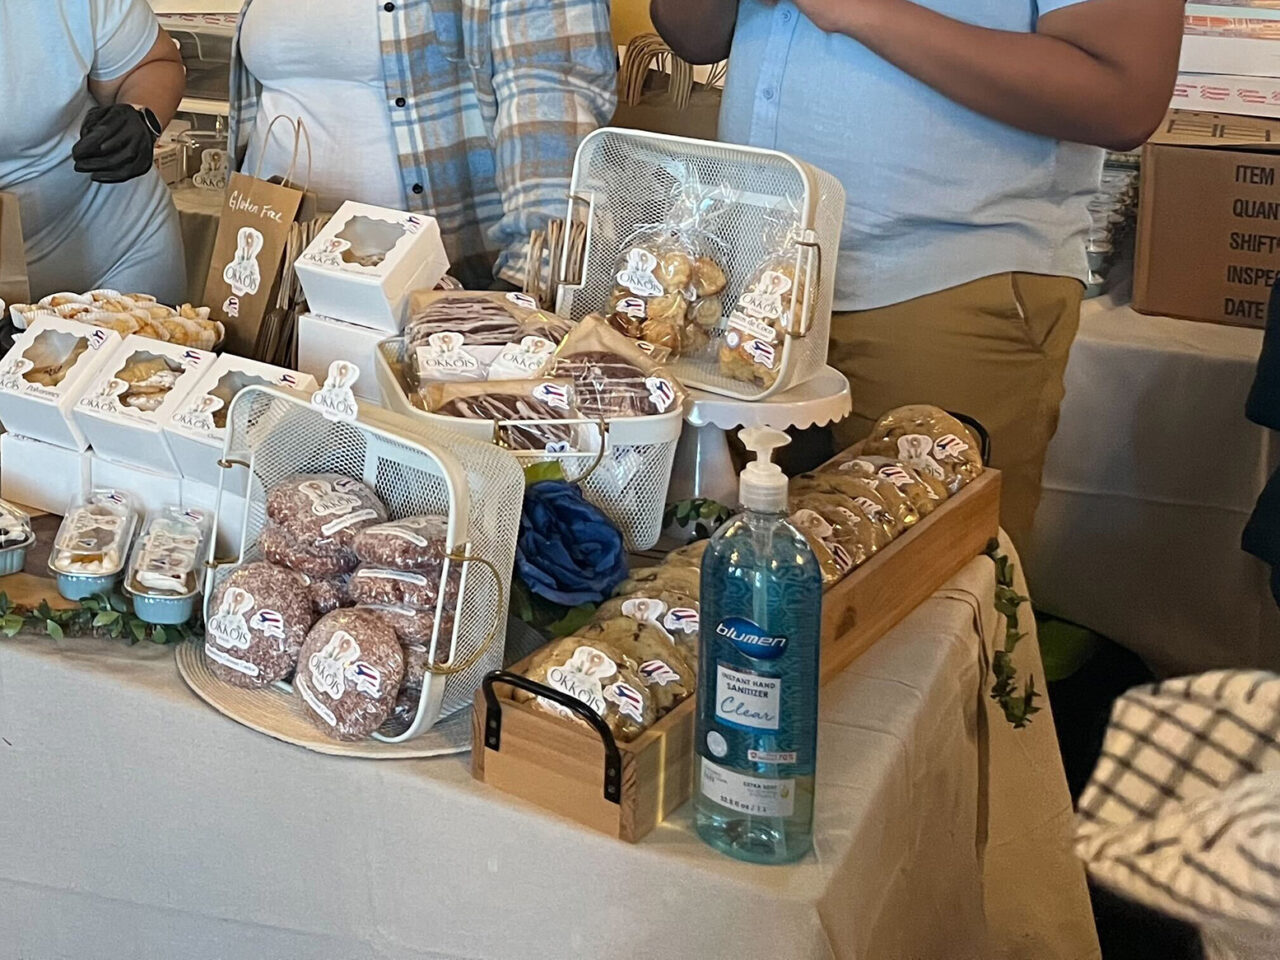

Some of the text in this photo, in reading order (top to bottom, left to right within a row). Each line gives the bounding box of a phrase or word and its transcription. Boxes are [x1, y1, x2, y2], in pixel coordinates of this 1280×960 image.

[1235, 165, 1275, 186] ITEM
[229, 190, 259, 212] Gluten
[1224, 297, 1264, 319] DATE
[716, 622, 787, 647] blumen
[752, 679, 776, 689] HAND
[720, 696, 776, 721] Clear
